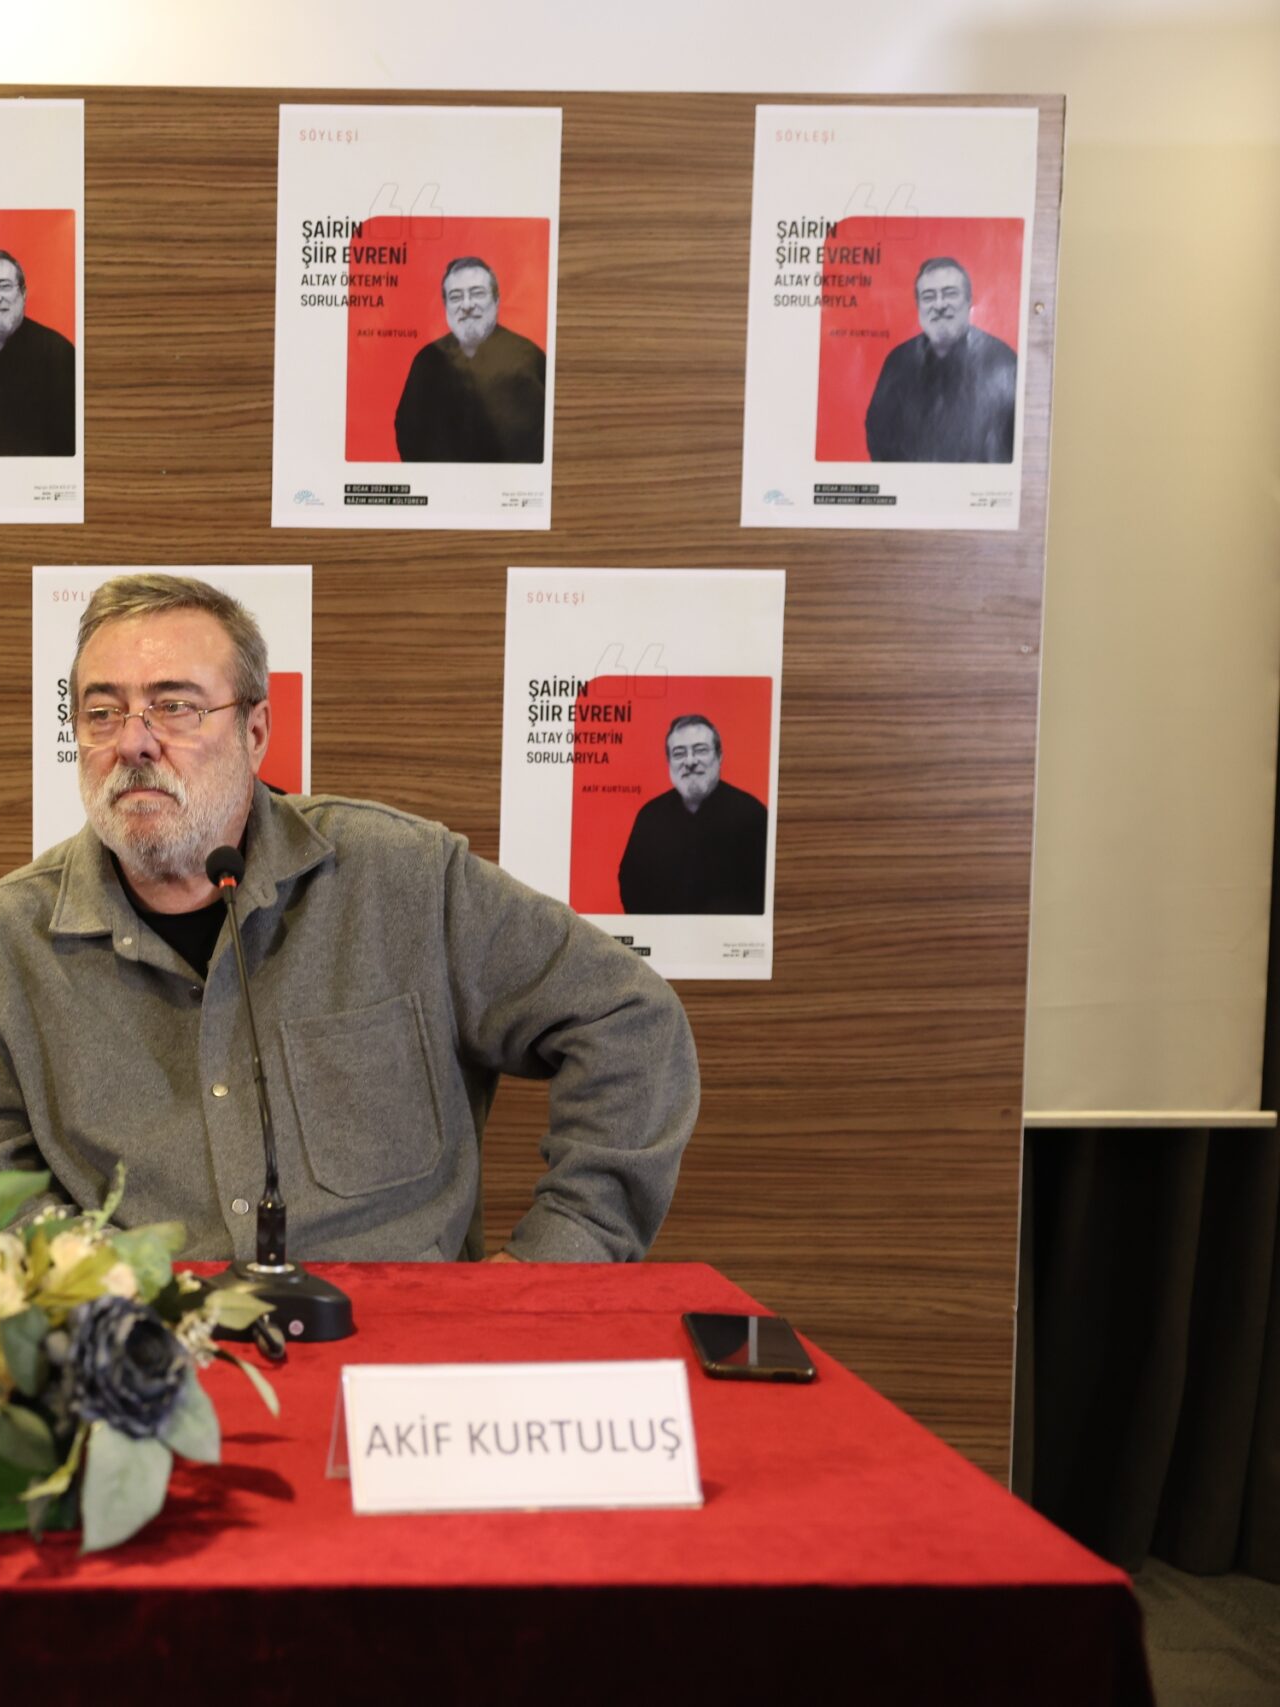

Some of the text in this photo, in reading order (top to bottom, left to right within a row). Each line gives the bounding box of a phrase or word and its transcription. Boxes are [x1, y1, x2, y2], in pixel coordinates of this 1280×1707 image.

[302, 215, 363, 244] ŞAİRİN
[302, 241, 407, 269] ŞİİR EVRENİ
[301, 274, 337, 287] ALTAY
[300, 294, 385, 307] SORULARIYLA
[526, 590, 584, 606] SÖYLEŞİ
[529, 675, 589, 702] ŞAİRİN
[528, 699, 632, 727] ŞİİR EVRENİ
[527, 732, 563, 744] ALTAY
[526, 751, 609, 764] SORULARIYLA
[582, 784, 641, 794] AKİF KURTULUŞ
[366, 1414, 681, 1460] AKİF KURTULUŞ
